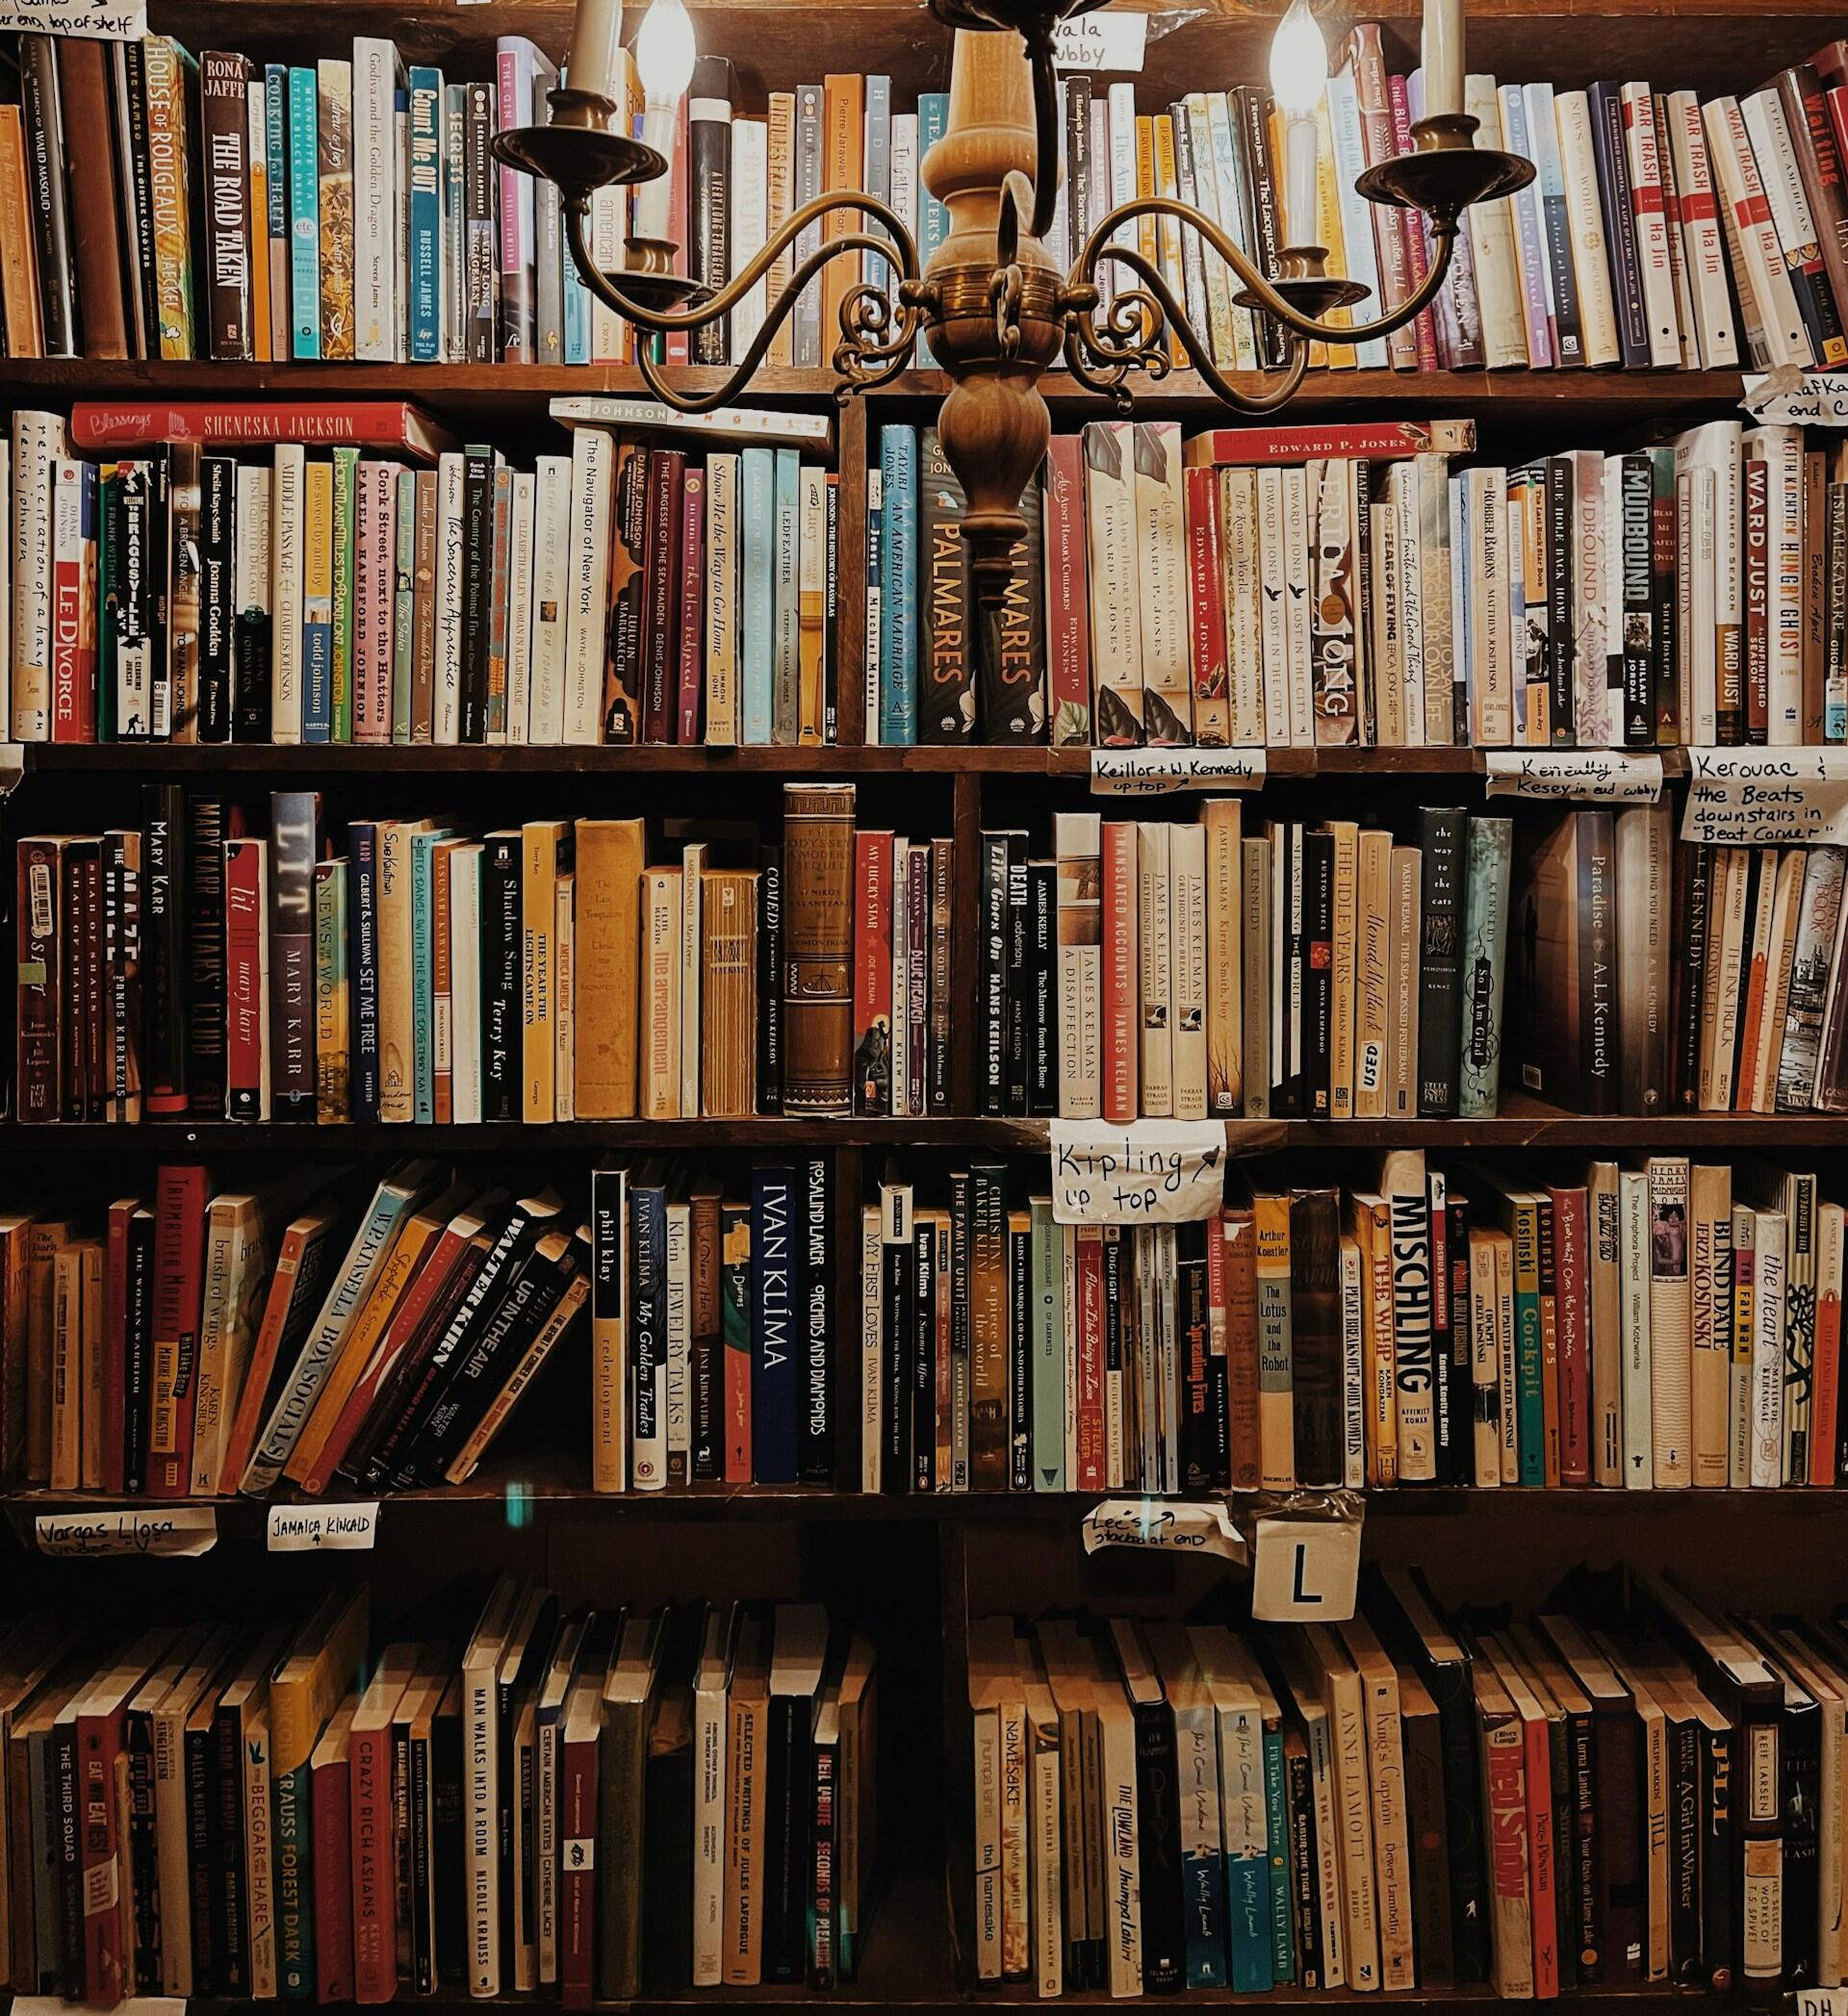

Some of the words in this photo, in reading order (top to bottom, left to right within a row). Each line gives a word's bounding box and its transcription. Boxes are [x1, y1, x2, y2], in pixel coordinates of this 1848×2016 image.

[49, 13, 72, 35] top
[74, 15, 91, 29] of
[92, 15, 133, 35] shelf
[146, 46, 170, 109] HOUSE
[204, 80, 244, 99] JAFFE
[206, 60, 244, 79] RONA
[371, 53, 381, 93] Godiva
[370, 100, 380, 121] and
[413, 89, 437, 133] Count
[1637, 95, 1652, 126] WAR
[212, 133, 241, 170] THE
[370, 125, 380, 141] the
[413, 138, 437, 162] Me
[1804, 94, 1837, 187] Waiting
[370, 147, 381, 189] Golden
[1641, 132, 1657, 181] TRASH
[38, 166, 50, 211] MASOUD
[151, 133, 177, 237] ROUGEAUX
[215, 175, 243, 226] ROAD
[413, 166, 436, 194] OUT
[368, 194, 381, 237] Dragon
[1649, 223, 1659, 242] Ha
[216, 229, 244, 289] TAKEN
[420, 229, 432, 275] RUSSELL
[1651, 246, 1663, 268] Jin
[162, 252, 177, 309] JAECKEL
[421, 279, 432, 318] JAMES
[90, 412, 150, 436] Blessings
[289, 415, 354, 435] JACKSON
[593, 404, 666, 419] JOHNSON
[1787, 401, 1821, 416] end
[585, 439, 598, 463] The
[1269, 442, 1332, 453] EDWARD
[1360, 439, 1406, 448] JONES
[713, 462, 726, 491] Show
[583, 470, 595, 533] Navigator
[713, 494, 725, 512] Me
[892, 502, 903, 522] AN
[1484, 487, 1495, 533] ROBBER
[1747, 470, 1765, 548] WARD
[583, 536, 592, 550] of
[713, 518, 724, 536] the
[1626, 470, 1649, 600] MUDBOUND
[581, 553, 591, 581] New
[711, 540, 724, 574] Way
[891, 528, 904, 606] AMERICAN
[1484, 536, 1495, 579] BARONS
[1781, 542, 1798, 603] HUNGRY
[59, 585, 77, 615] LE
[208, 558, 221, 602] Joanna
[579, 586, 590, 615] York
[713, 578, 722, 589] to
[1747, 561, 1765, 618] JUST
[713, 593, 723, 613] Go
[932, 523, 962, 683] PALMARES
[209, 605, 222, 656] Godden
[713, 621, 723, 656] Home
[892, 612, 904, 690] MARRIAGE
[1781, 608, 1798, 658] GHOST
[1096, 761, 1155, 778] Keillor
[1190, 760, 1252, 778] Kennedy
[1135, 779, 1167, 792] top
[1697, 757, 1798, 778] Kerouac
[1518, 780, 1570, 797] Kesey
[1694, 788, 1727, 804] the
[1743, 787, 1804, 804] Beats
[1695, 806, 1795, 823] downstairs
[1804, 807, 1820, 822] in
[278, 823, 309, 912] LIT
[990, 845, 1005, 881] Life
[503, 880, 517, 941] Shadow
[990, 886, 1003, 931] Goes
[1592, 855, 1604, 930] Paradise
[990, 936, 1001, 960] On
[287, 950, 301, 1006] MARY
[501, 951, 517, 990] Song
[989, 974, 1000, 1015] HANS
[492, 1000, 505, 1043] Terry
[1593, 1003, 1608, 1077] Kennedy
[288, 1019, 301, 1075] KARR
[490, 1050, 505, 1080] Kay
[988, 1021, 1000, 1085] KEILSON
[1364, 1043, 1377, 1087] USED
[1059, 1137, 1182, 1191] Kipling
[1113, 1187, 1157, 1212] top
[599, 1211, 614, 1245] phil
[762, 1186, 785, 1259] IVAN
[1259, 1230, 1285, 1242] Arthur
[471, 1217, 526, 1312] WALTER
[1257, 1245, 1288, 1256] Koestler
[1694, 1221, 1710, 1268] JERZY
[1713, 1221, 1731, 1284] BLIND
[599, 1250, 614, 1284] klay
[1765, 1256, 1777, 1288] the
[1261, 1303, 1286, 1317] Lotus
[1265, 1286, 1280, 1298] The
[1393, 1194, 1431, 1394] MISCHLING
[1694, 1269, 1710, 1351] KOSINSKI
[432, 1312, 473, 1366] KIRN
[1267, 1322, 1282, 1335] and
[1713, 1291, 1731, 1350] DATE
[1763, 1292, 1779, 1348] heart
[1262, 1356, 1290, 1371] Robot
[1269, 1340, 1282, 1351] the
[1523, 1308, 1538, 1397] Cockpit
[602, 1340, 611, 1444] redeployment
[273, 1515, 321, 1537] JAMAICA
[1293, 1544, 1322, 1603] L
[475, 1689, 486, 1718] MAN
[61, 1746, 70, 1769] THE
[475, 1723, 486, 1764] WALKS
[360, 1742, 371, 1800] CRAZY
[475, 1773, 487, 1800] INTO
[1758, 1766, 1769, 1812] LARSEN
[62, 1773, 72, 1813] THIRD
[63, 1817, 73, 1862] SQUAD
[361, 1807, 372, 1849] RICH
[475, 1818, 487, 1856] ROOM
[282, 1845, 298, 1909] FOREST
[362, 1853, 373, 1918] ASIANS
[477, 1871, 488, 1914] NICOLE
[284, 1914, 301, 1962] DARK
[477, 1920, 488, 1966] KRAUSS
